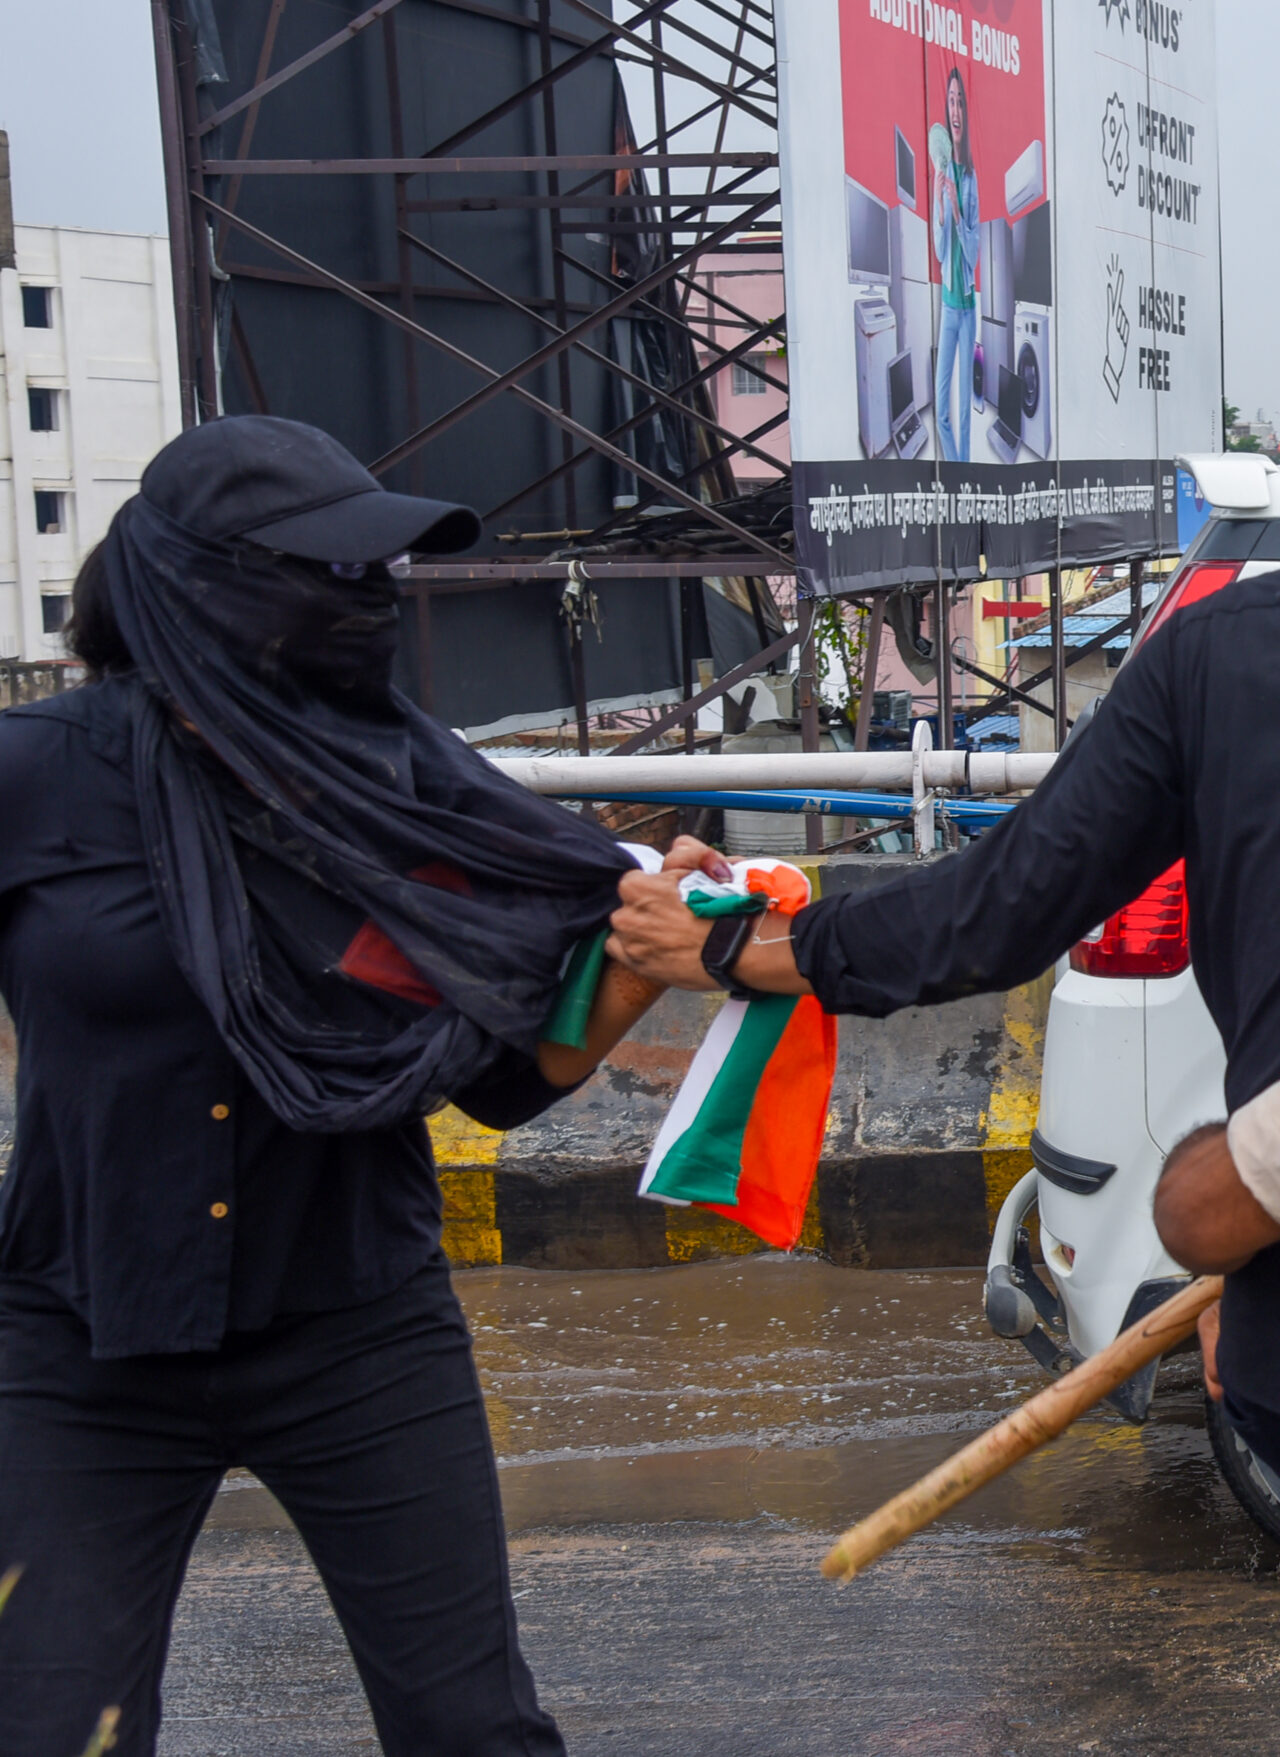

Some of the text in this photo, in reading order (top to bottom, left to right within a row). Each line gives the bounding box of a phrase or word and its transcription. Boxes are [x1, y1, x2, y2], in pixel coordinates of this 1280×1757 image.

[972, 20, 1020, 76] BONUS
[1137, 102, 1195, 166] UPFRONT
[1139, 286, 1186, 336] HASSLE
[1139, 347, 1170, 391] FREE
